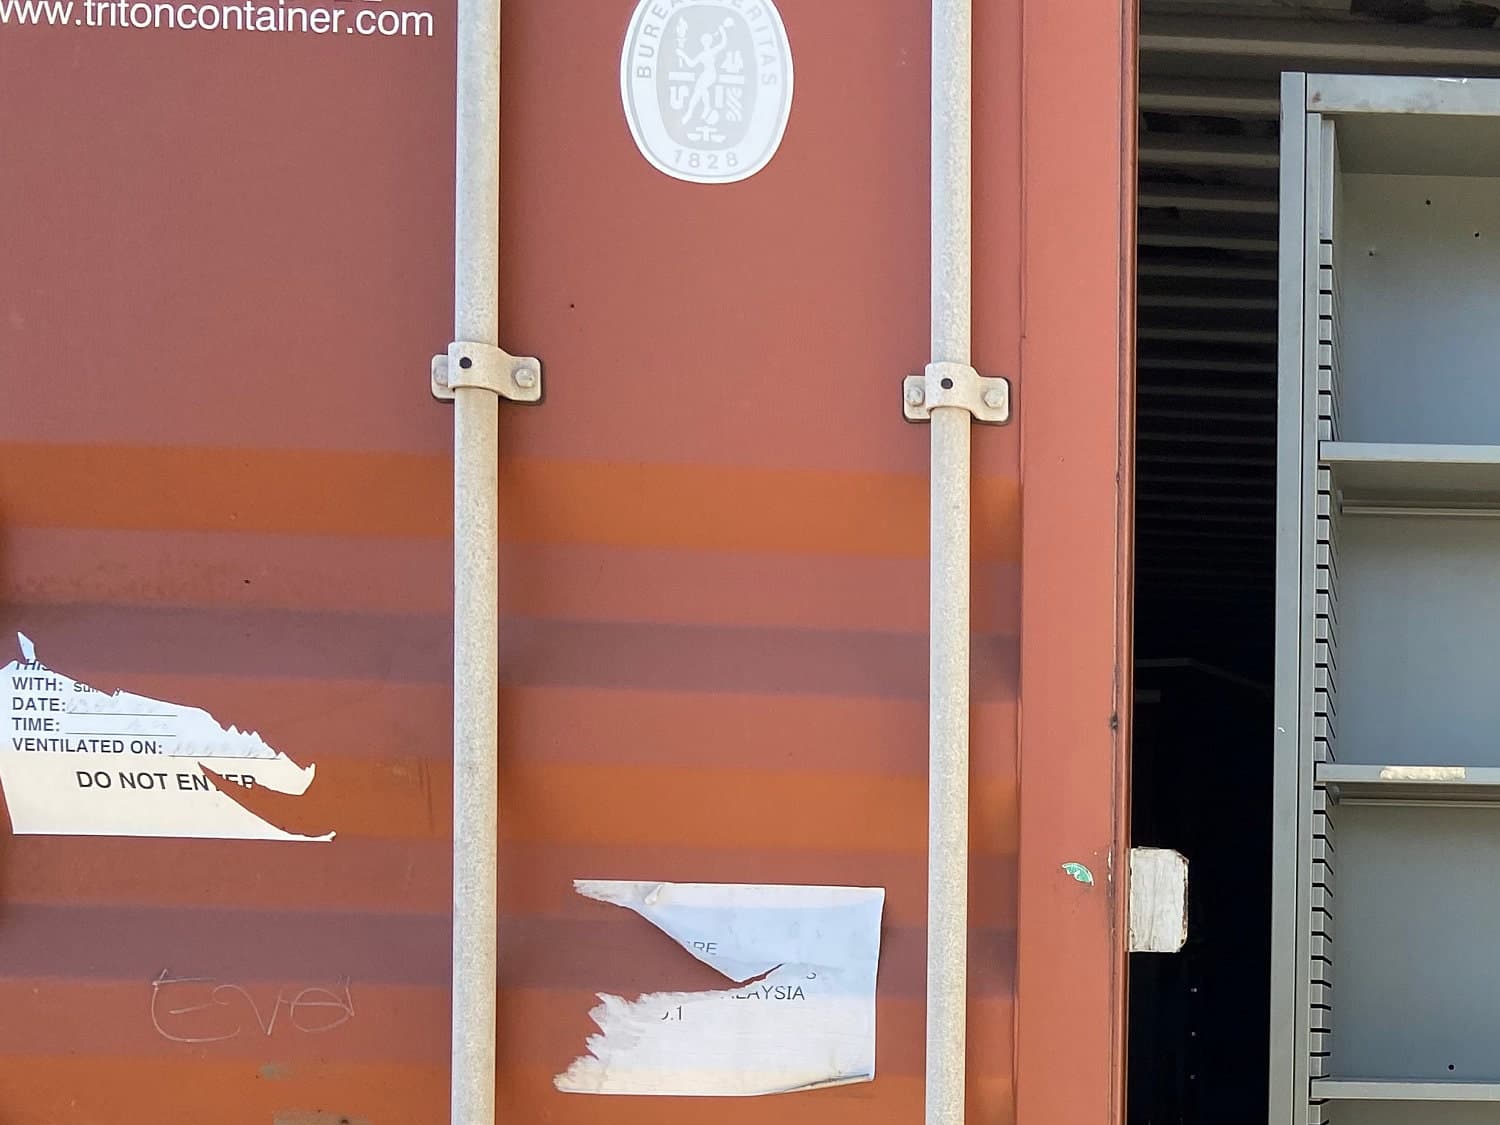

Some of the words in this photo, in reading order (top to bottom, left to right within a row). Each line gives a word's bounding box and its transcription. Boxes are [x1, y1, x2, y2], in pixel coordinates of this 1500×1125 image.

[675, 150, 738, 169] 1828
[12, 676, 63, 692] WITH:
[12, 697, 66, 712] DATE:
[12, 717, 60, 732] TIME:
[12, 738, 124, 753] VENTILATED
[130, 740, 163, 754] ON:
[76, 771, 111, 789] DO
[119, 772, 168, 790] NOT
